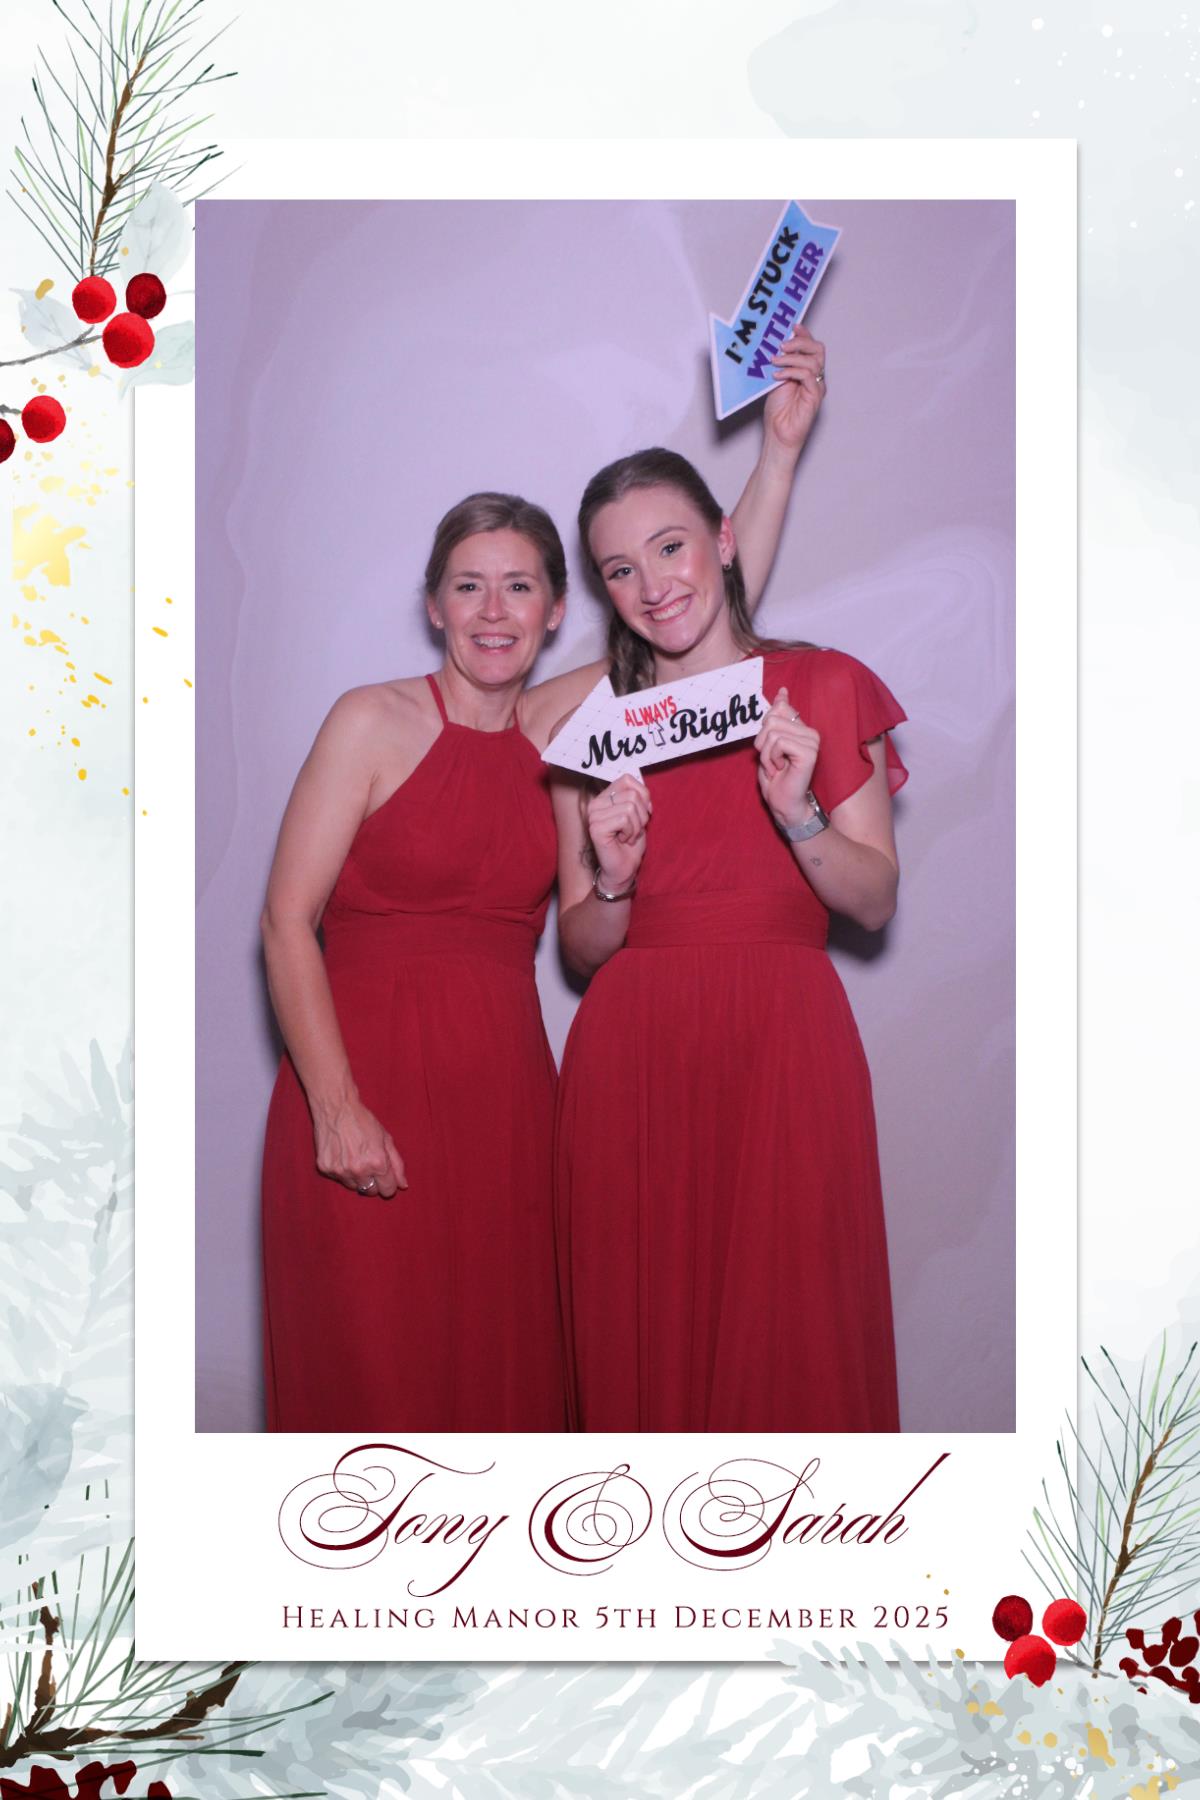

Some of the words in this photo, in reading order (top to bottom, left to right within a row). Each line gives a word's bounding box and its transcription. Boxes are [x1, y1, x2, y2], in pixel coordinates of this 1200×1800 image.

[725, 319, 757, 364] I'M
[748, 226, 799, 315] STUCK
[747, 300, 796, 379] WITH
[784, 241, 824, 302] HER
[581, 730, 647, 769] Mrs
[669, 694, 763, 744] Right
[624, 695, 677, 727] ALWAYS
